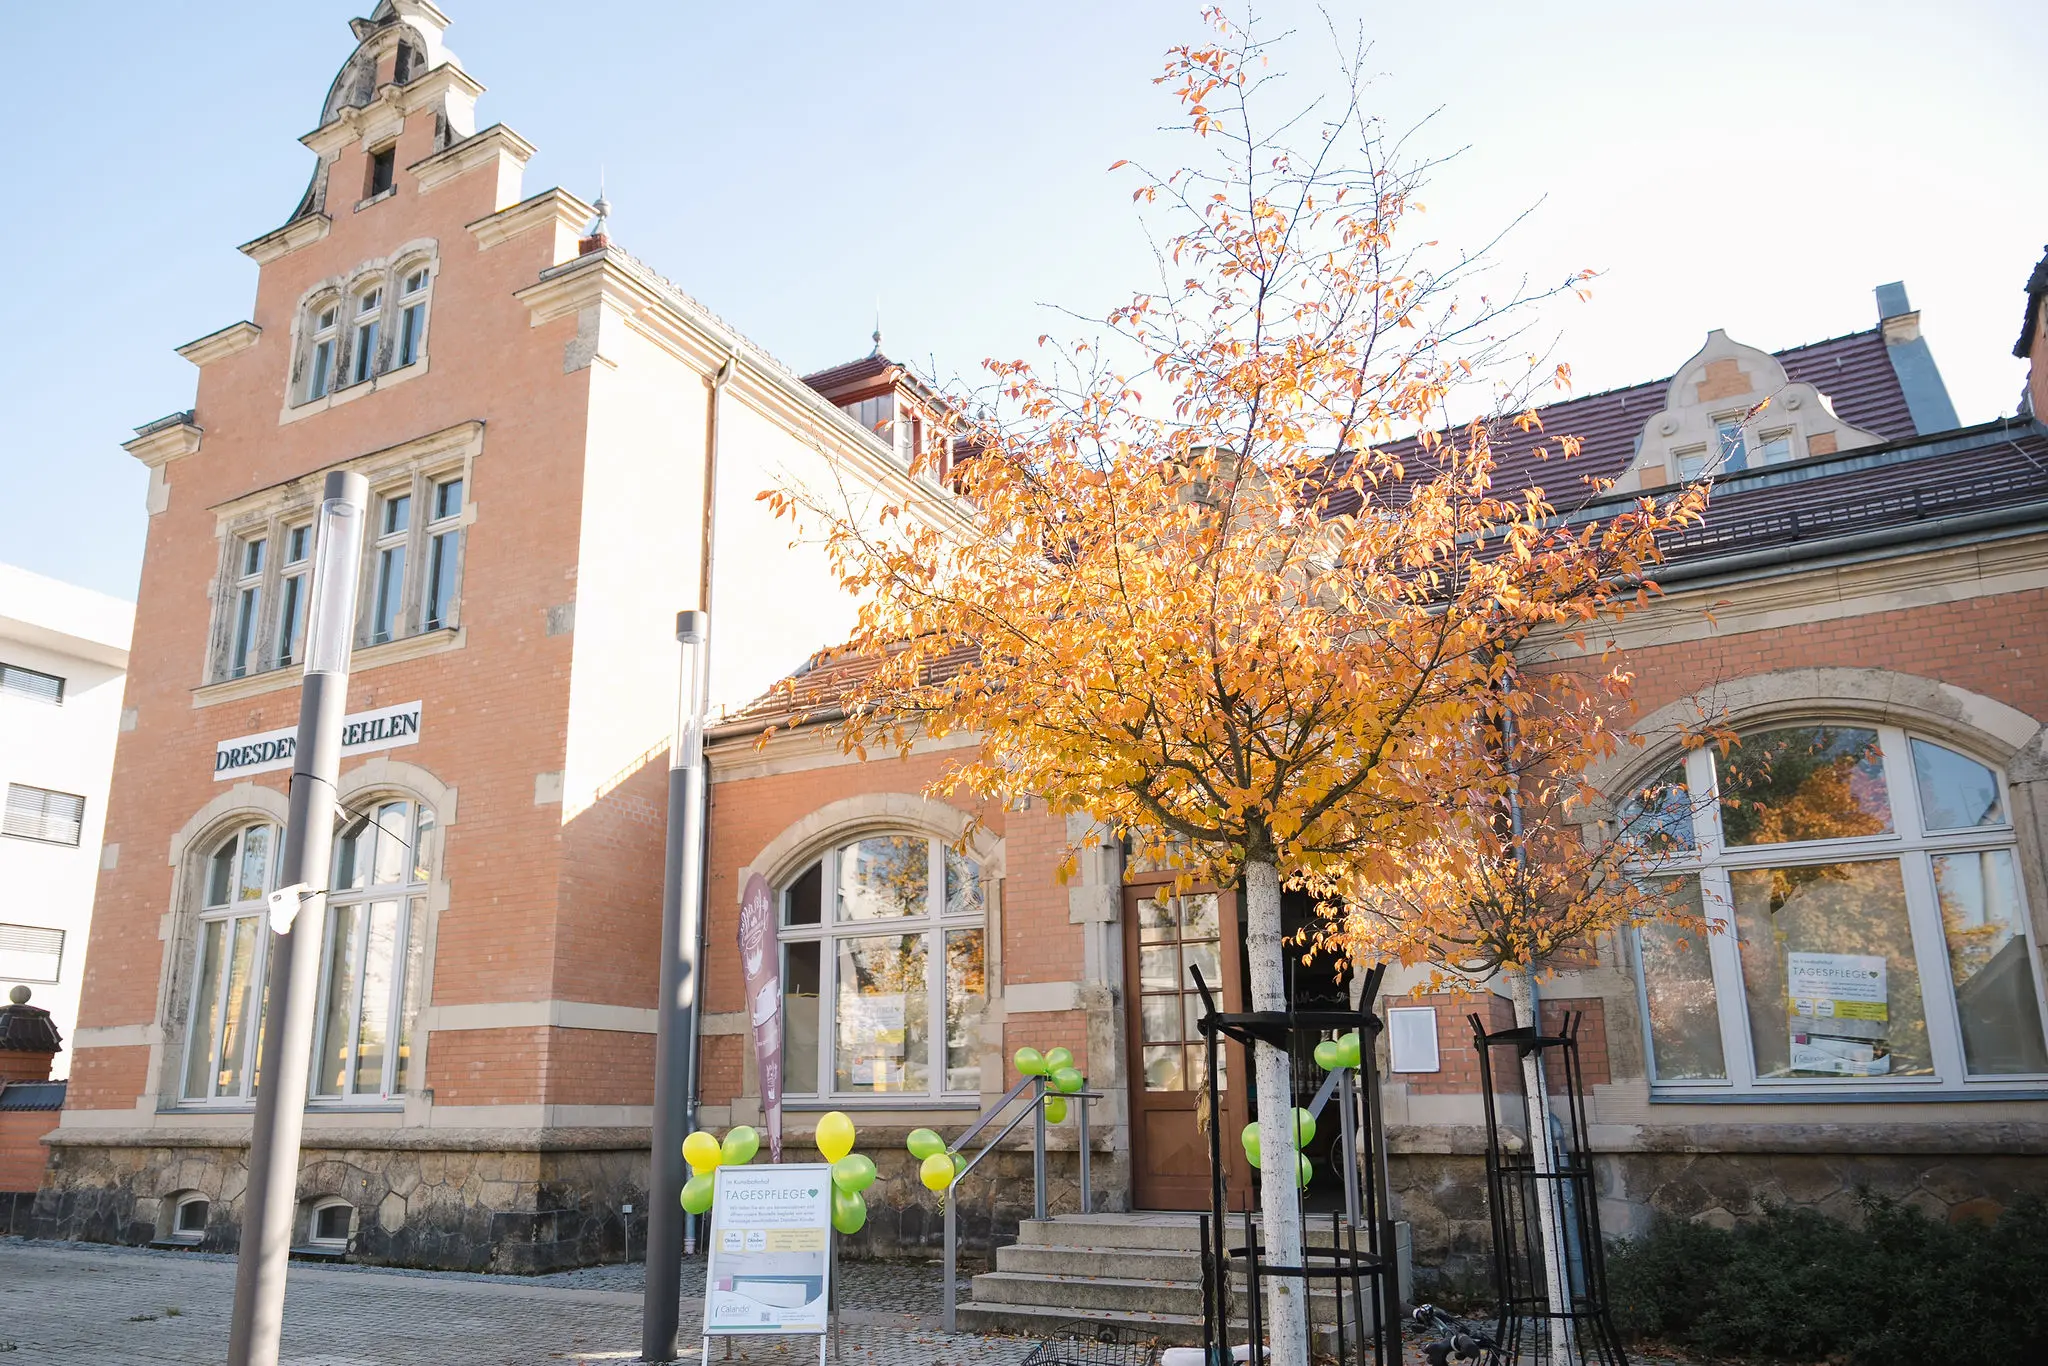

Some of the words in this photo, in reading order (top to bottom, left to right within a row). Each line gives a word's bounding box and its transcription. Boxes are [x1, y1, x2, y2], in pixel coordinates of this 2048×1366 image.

[215, 737, 297, 771] DRESDEN
[341, 711, 419, 747] REHLEN
[1793, 967, 1868, 979] TAGESPFLEGE
[725, 1188, 806, 1200] TAGESPFLEGE
[720, 1304, 750, 1314] Calando
